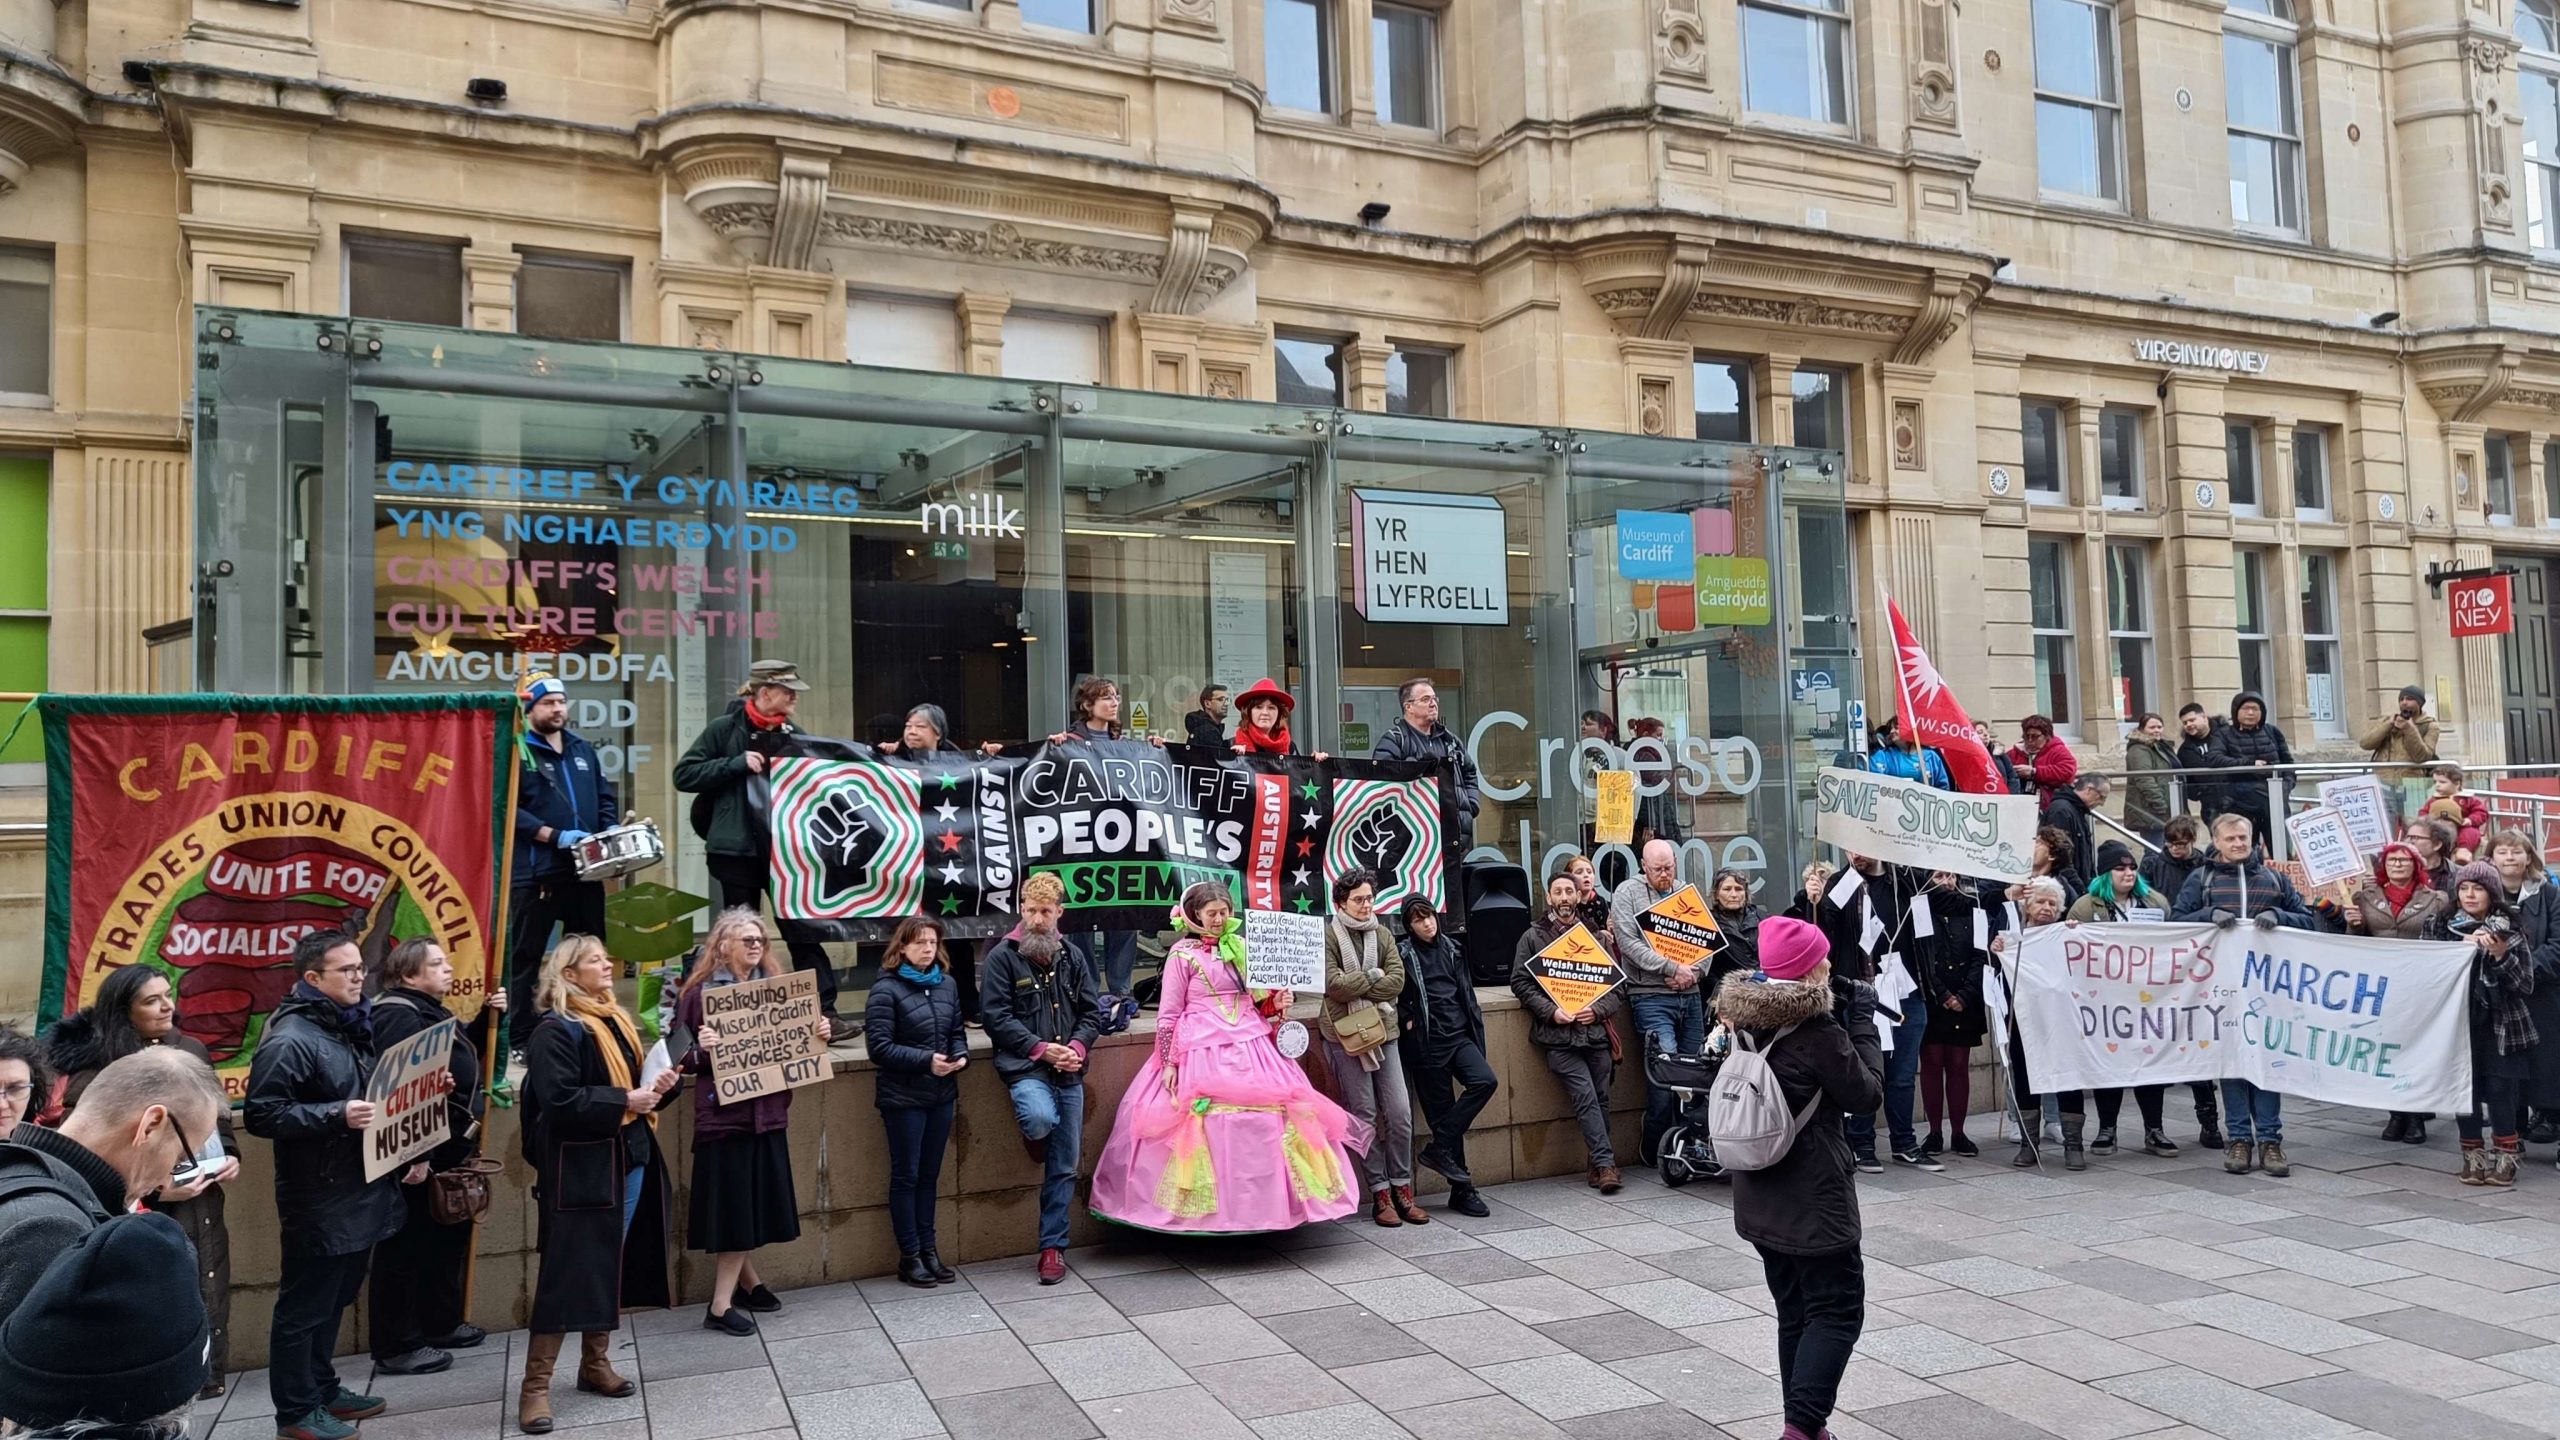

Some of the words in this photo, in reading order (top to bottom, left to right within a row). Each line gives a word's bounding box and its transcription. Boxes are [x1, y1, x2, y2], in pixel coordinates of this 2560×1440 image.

[2136, 338, 2200, 366] VIRGIN
[2202, 345, 2270, 373] MONEY
[386, 460, 597, 499] CARTREF
[609, 473, 642, 504] Y
[657, 475, 859, 514] GYMRAEG
[386, 508, 485, 541] YNG
[504, 513, 797, 553] NGHAERDYDD
[921, 493, 1022, 540] milk
[1375, 517, 1408, 542] YR
[1622, 527, 1671, 544] Museum
[1674, 528, 1686, 544] of
[1376, 550, 1427, 575] HEN
[1622, 543, 1674, 562] Cardiff
[386, 556, 616, 591] CARDIFF'S
[632, 563, 772, 595] WELSH
[1705, 575, 1767, 592] Amgueddfa
[1376, 583, 1499, 611] LYFRGELL
[1700, 591, 1768, 611] Caerdydd
[387, 603, 597, 636] CULTURE
[614, 607, 780, 640] CENTRE
[386, 651, 675, 682] AMGUEDDFA
[119, 731, 454, 802] CARDIFF
[597, 745, 654, 775] OF
[1468, 711, 1762, 801] Croeso
[1019, 759, 1250, 814] CARDIFF
[2334, 792, 2370, 807] SAVE
[1818, 774, 1881, 822] SAVE
[1880, 785, 1903, 800] OUR
[1898, 788, 1998, 847] STORY
[980, 766, 1012, 916] AGAINST
[1256, 779, 1284, 909] AUSTERITY
[1022, 807, 1245, 864] PEOPLE'S
[2301, 821, 2336, 840] SAVE
[2308, 835, 2339, 852] OUR
[95, 833, 206, 974] TRADES
[218, 801, 347, 834] UNION
[371, 825, 472, 955] COUNCIL
[209, 855, 312, 895] UNITE
[325, 862, 388, 902] FOR
[1650, 913, 1682, 931] Welsh
[1681, 922, 1717, 941] Liberal
[1654, 924, 1708, 948] Democrats
[1248, 944, 1262, 953] but
[1265, 945, 1278, 954] not
[1250, 972, 1289, 987] Austerity
[1290, 973, 1312, 986] Cuts
[1541, 958, 1574, 972] Welsh
[1575, 963, 1613, 975] Liberal
[1548, 969, 1604, 983] Democrats
[2064, 939, 2215, 987] PEOPLE'S
[2242, 949, 2390, 1017] MARCH
[790, 979, 811, 995] the
[1560, 995, 1584, 1003] Cymru
[2212, 985, 2239, 999] for
[769, 999, 813, 1027] Cardiff
[411, 1020, 457, 1067] CITY
[715, 1035, 760, 1059] Erases
[717, 1057, 737, 1072] and
[736, 1044, 792, 1070] VOICES
[795, 1038, 810, 1055] of
[2080, 1004, 2226, 1042] DIGNITY
[2222, 1017, 2239, 1029] and
[2241, 1008, 2402, 1079] CULTURE
[386, 1065, 448, 1118] CULTURE
[721, 1072, 764, 1098] OUR
[785, 1055, 821, 1084] CITY
[376, 1097, 447, 1162] MUSEUM
